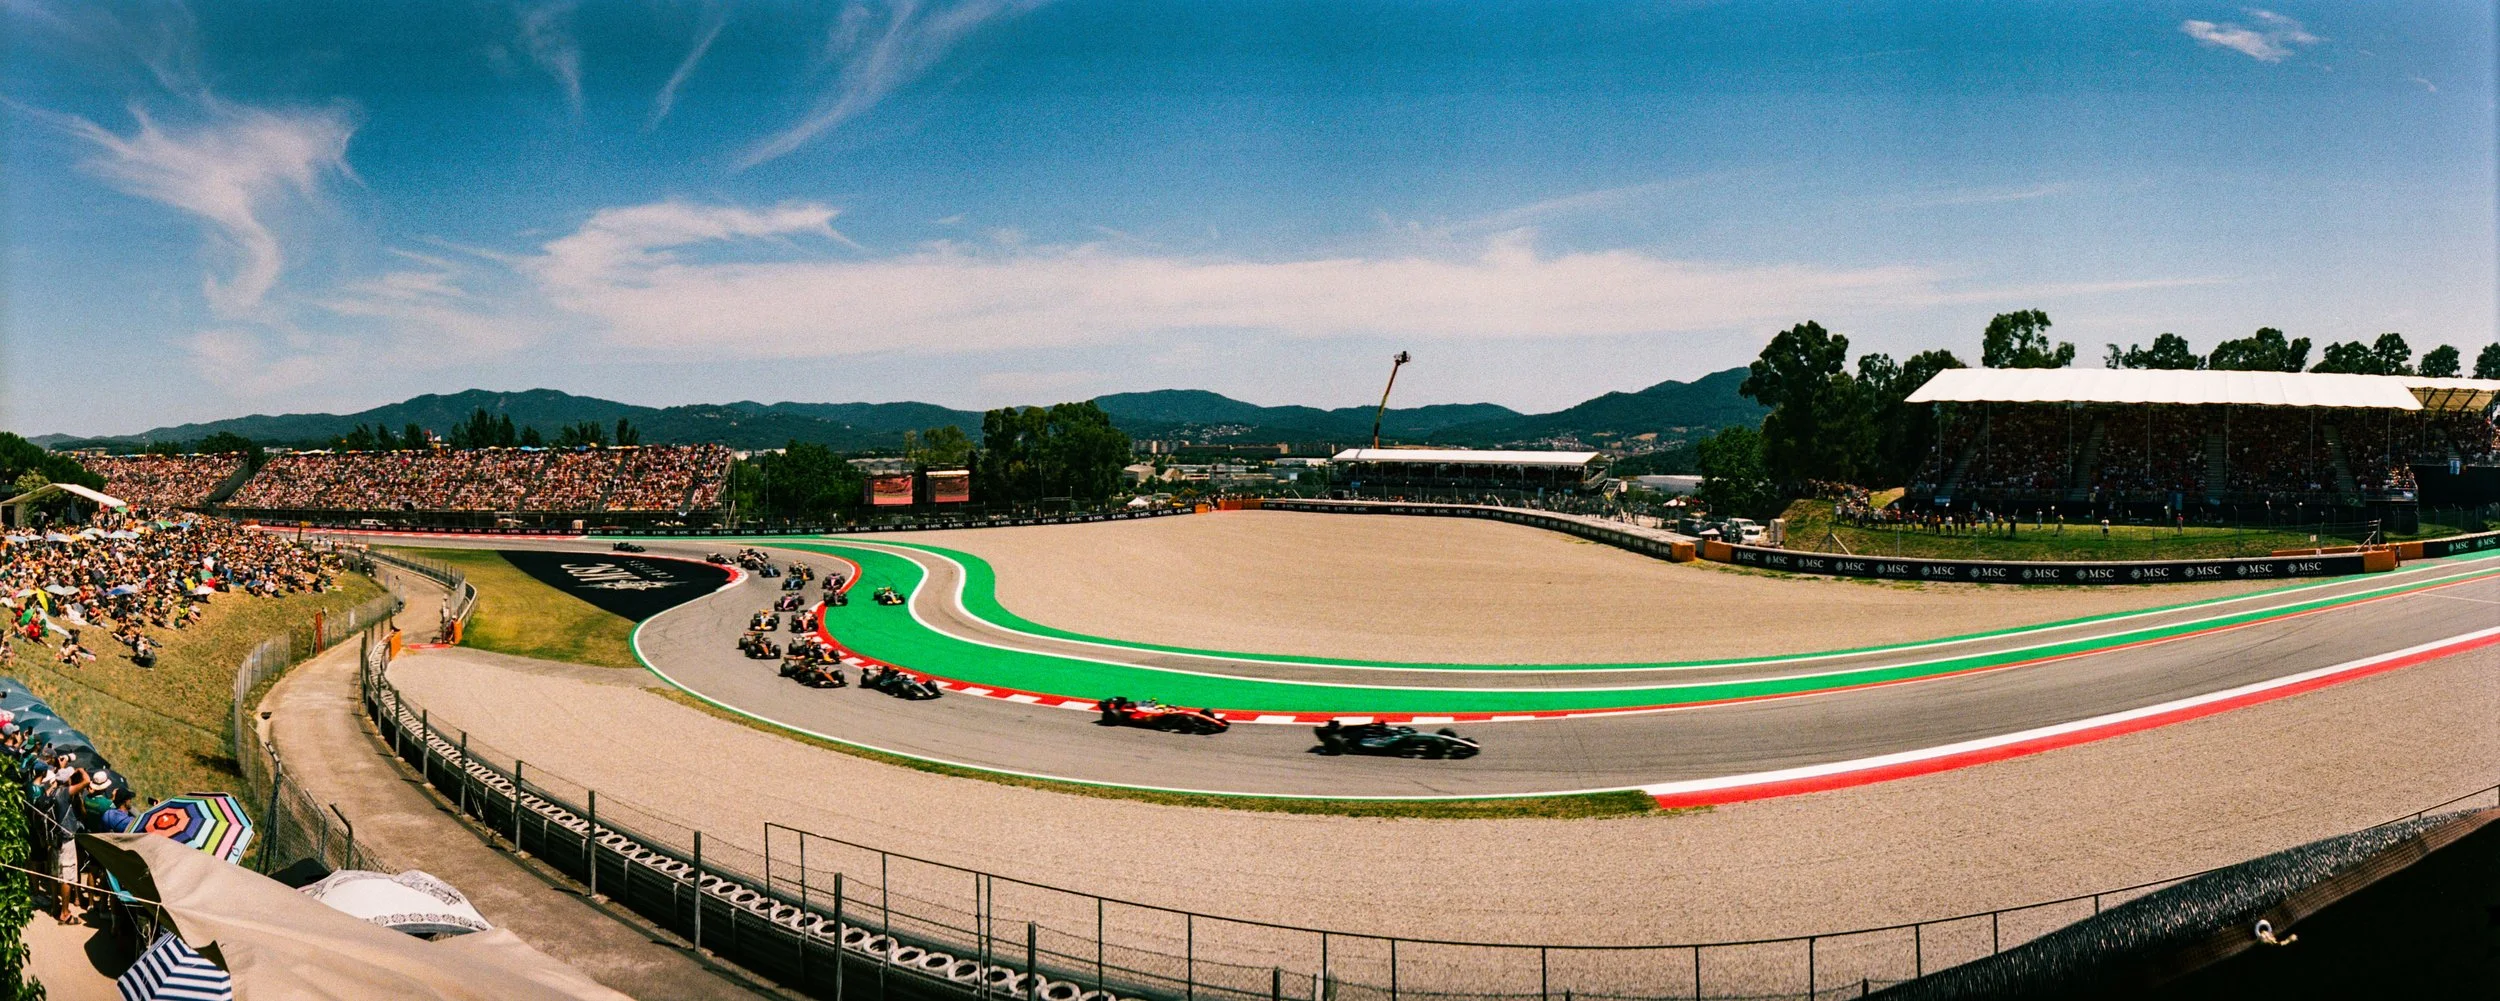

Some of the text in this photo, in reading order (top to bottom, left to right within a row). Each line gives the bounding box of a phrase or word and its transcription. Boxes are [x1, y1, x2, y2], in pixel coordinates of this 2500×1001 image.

[2455, 541, 2469, 549] MSC
[2483, 537, 2496, 546] MSC
[1772, 555, 1788, 565] MSC
[1806, 559, 1824, 568] MSC
[1845, 562, 1865, 571] MSC
[1886, 564, 1908, 573] MSC
[1932, 566, 1955, 575] MSC
[2197, 566, 2221, 575] MSC
[2249, 564, 2273, 573] MSC
[2299, 562, 2322, 571] MSC
[1982, 568, 2006, 577] MSC
[2034, 569, 2059, 578] MSC
[2089, 569, 2114, 578] MSC
[2143, 568, 2169, 577] MSC
